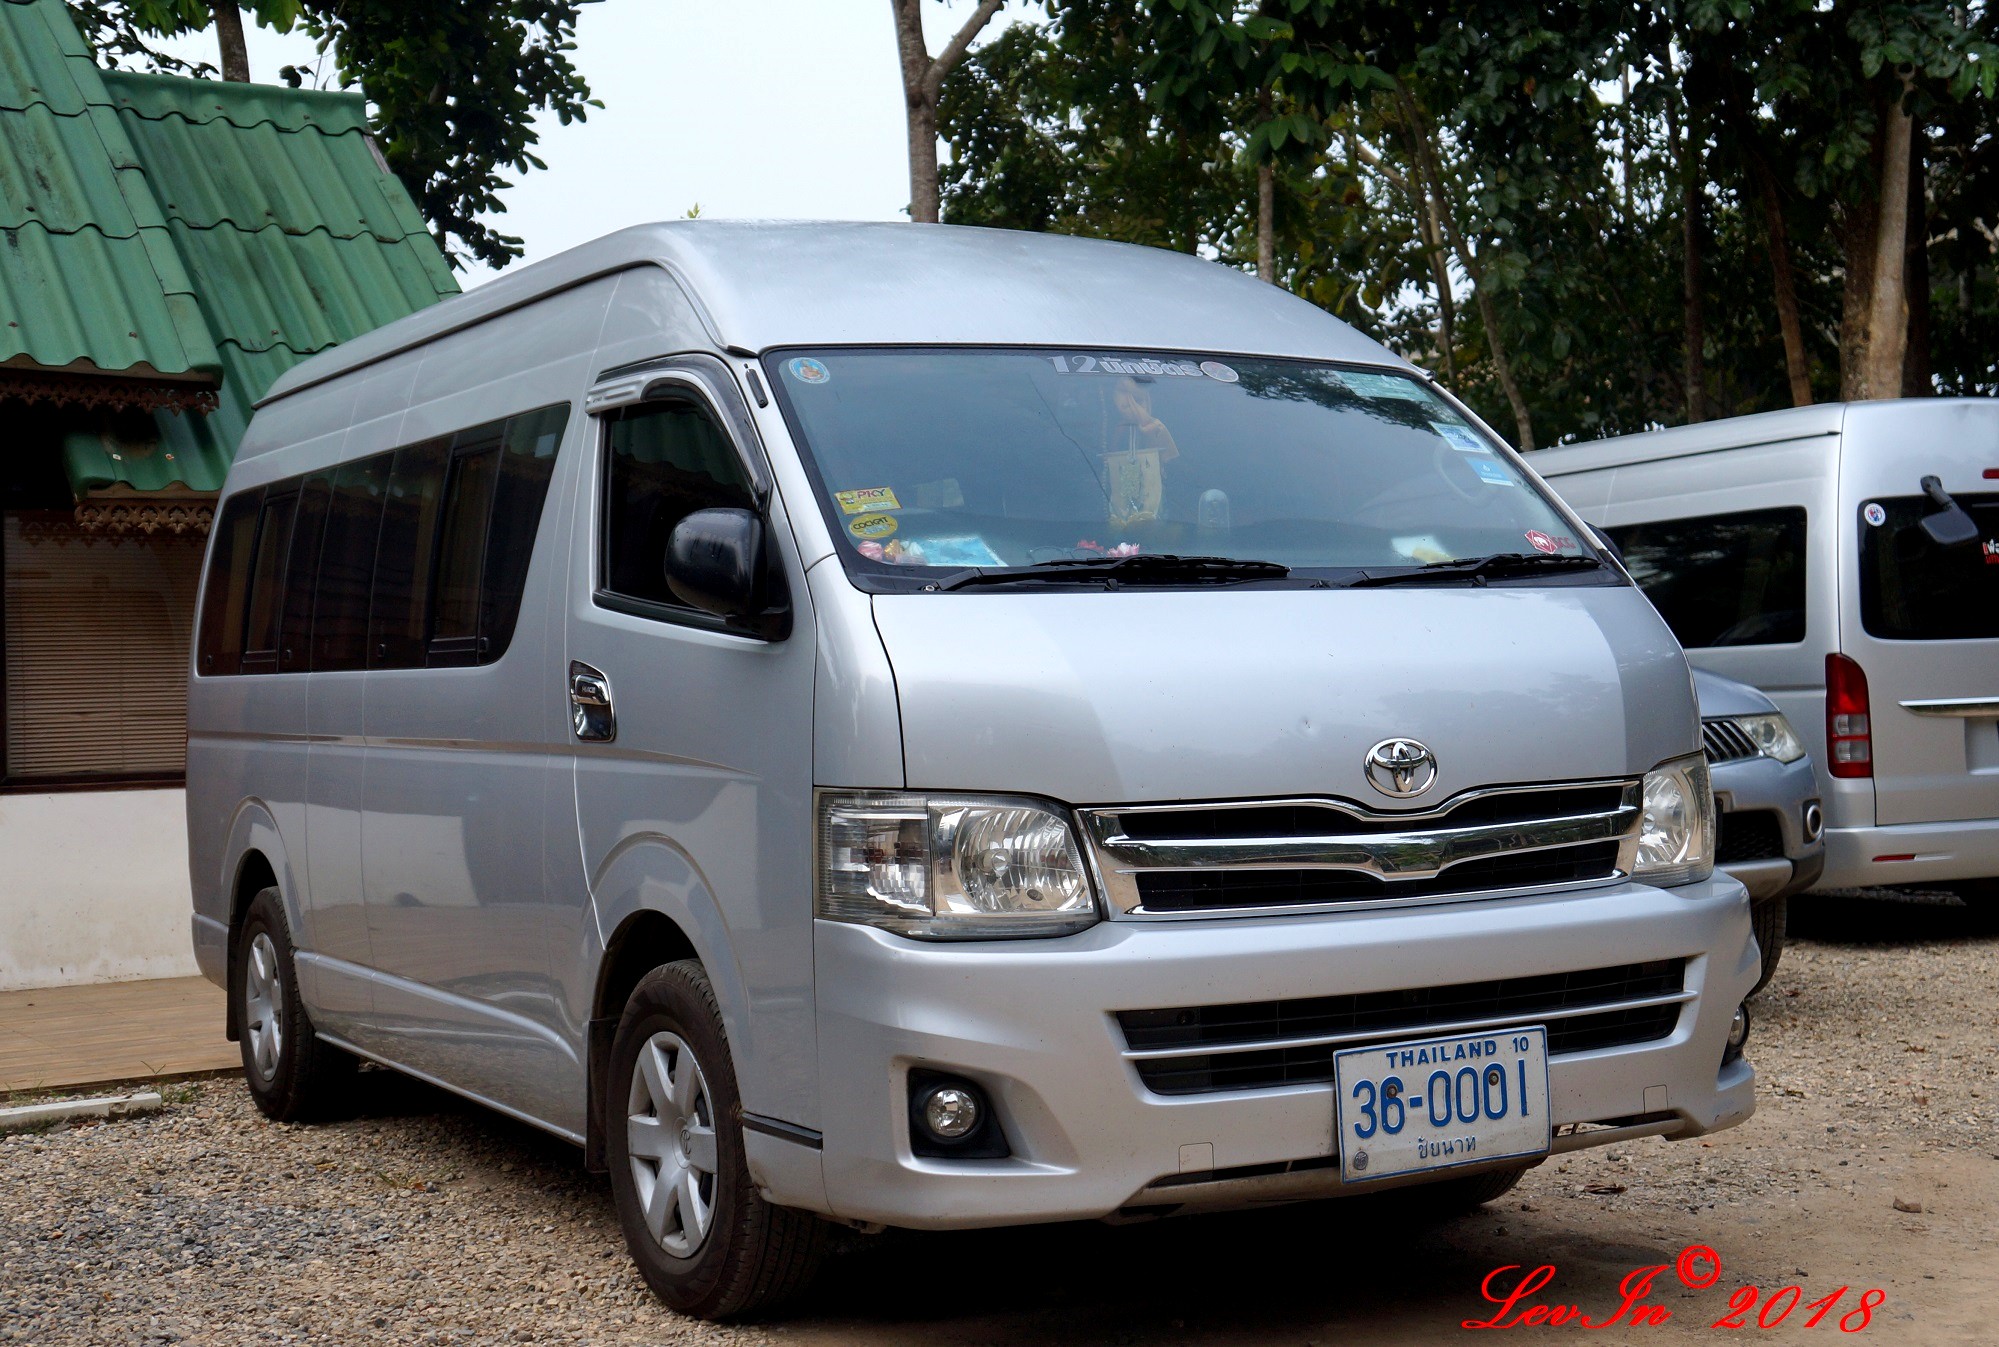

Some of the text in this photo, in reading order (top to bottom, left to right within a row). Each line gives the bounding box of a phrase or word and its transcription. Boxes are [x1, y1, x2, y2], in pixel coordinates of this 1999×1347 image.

[857, 488, 886, 499] PKY
[1385, 1036, 1530, 1069] THAILAND 10
[1352, 1058, 1529, 1139] 36-0001
[1417, 1135, 1477, 1159] ชัยนาท
